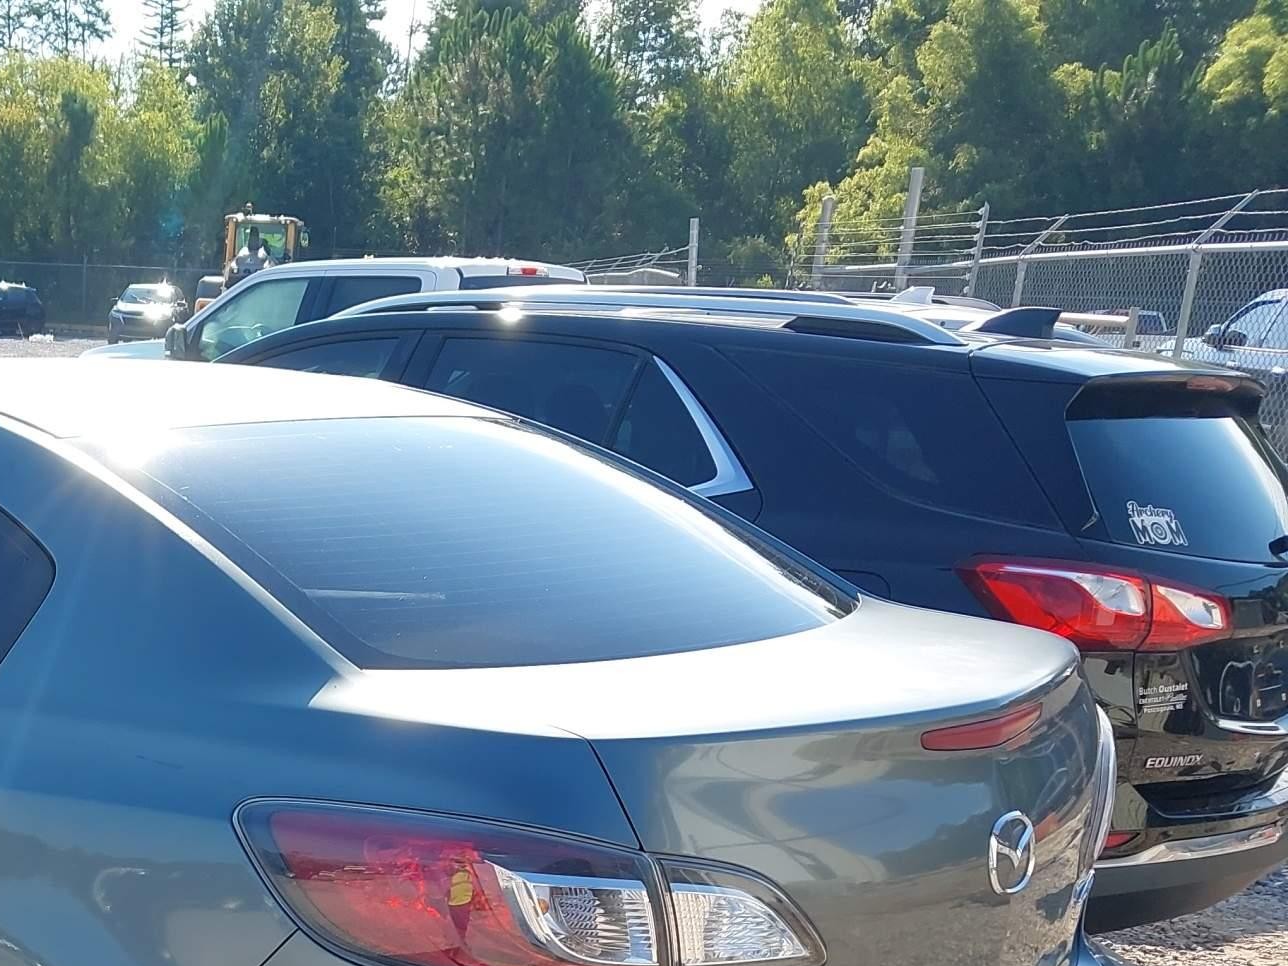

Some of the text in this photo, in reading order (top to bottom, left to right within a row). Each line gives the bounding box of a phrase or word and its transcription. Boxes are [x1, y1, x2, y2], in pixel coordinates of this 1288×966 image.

[1126, 500, 1175, 521] Archery
[1129, 518, 1188, 546] MOM
[1145, 754, 1204, 769] EQUINOX
